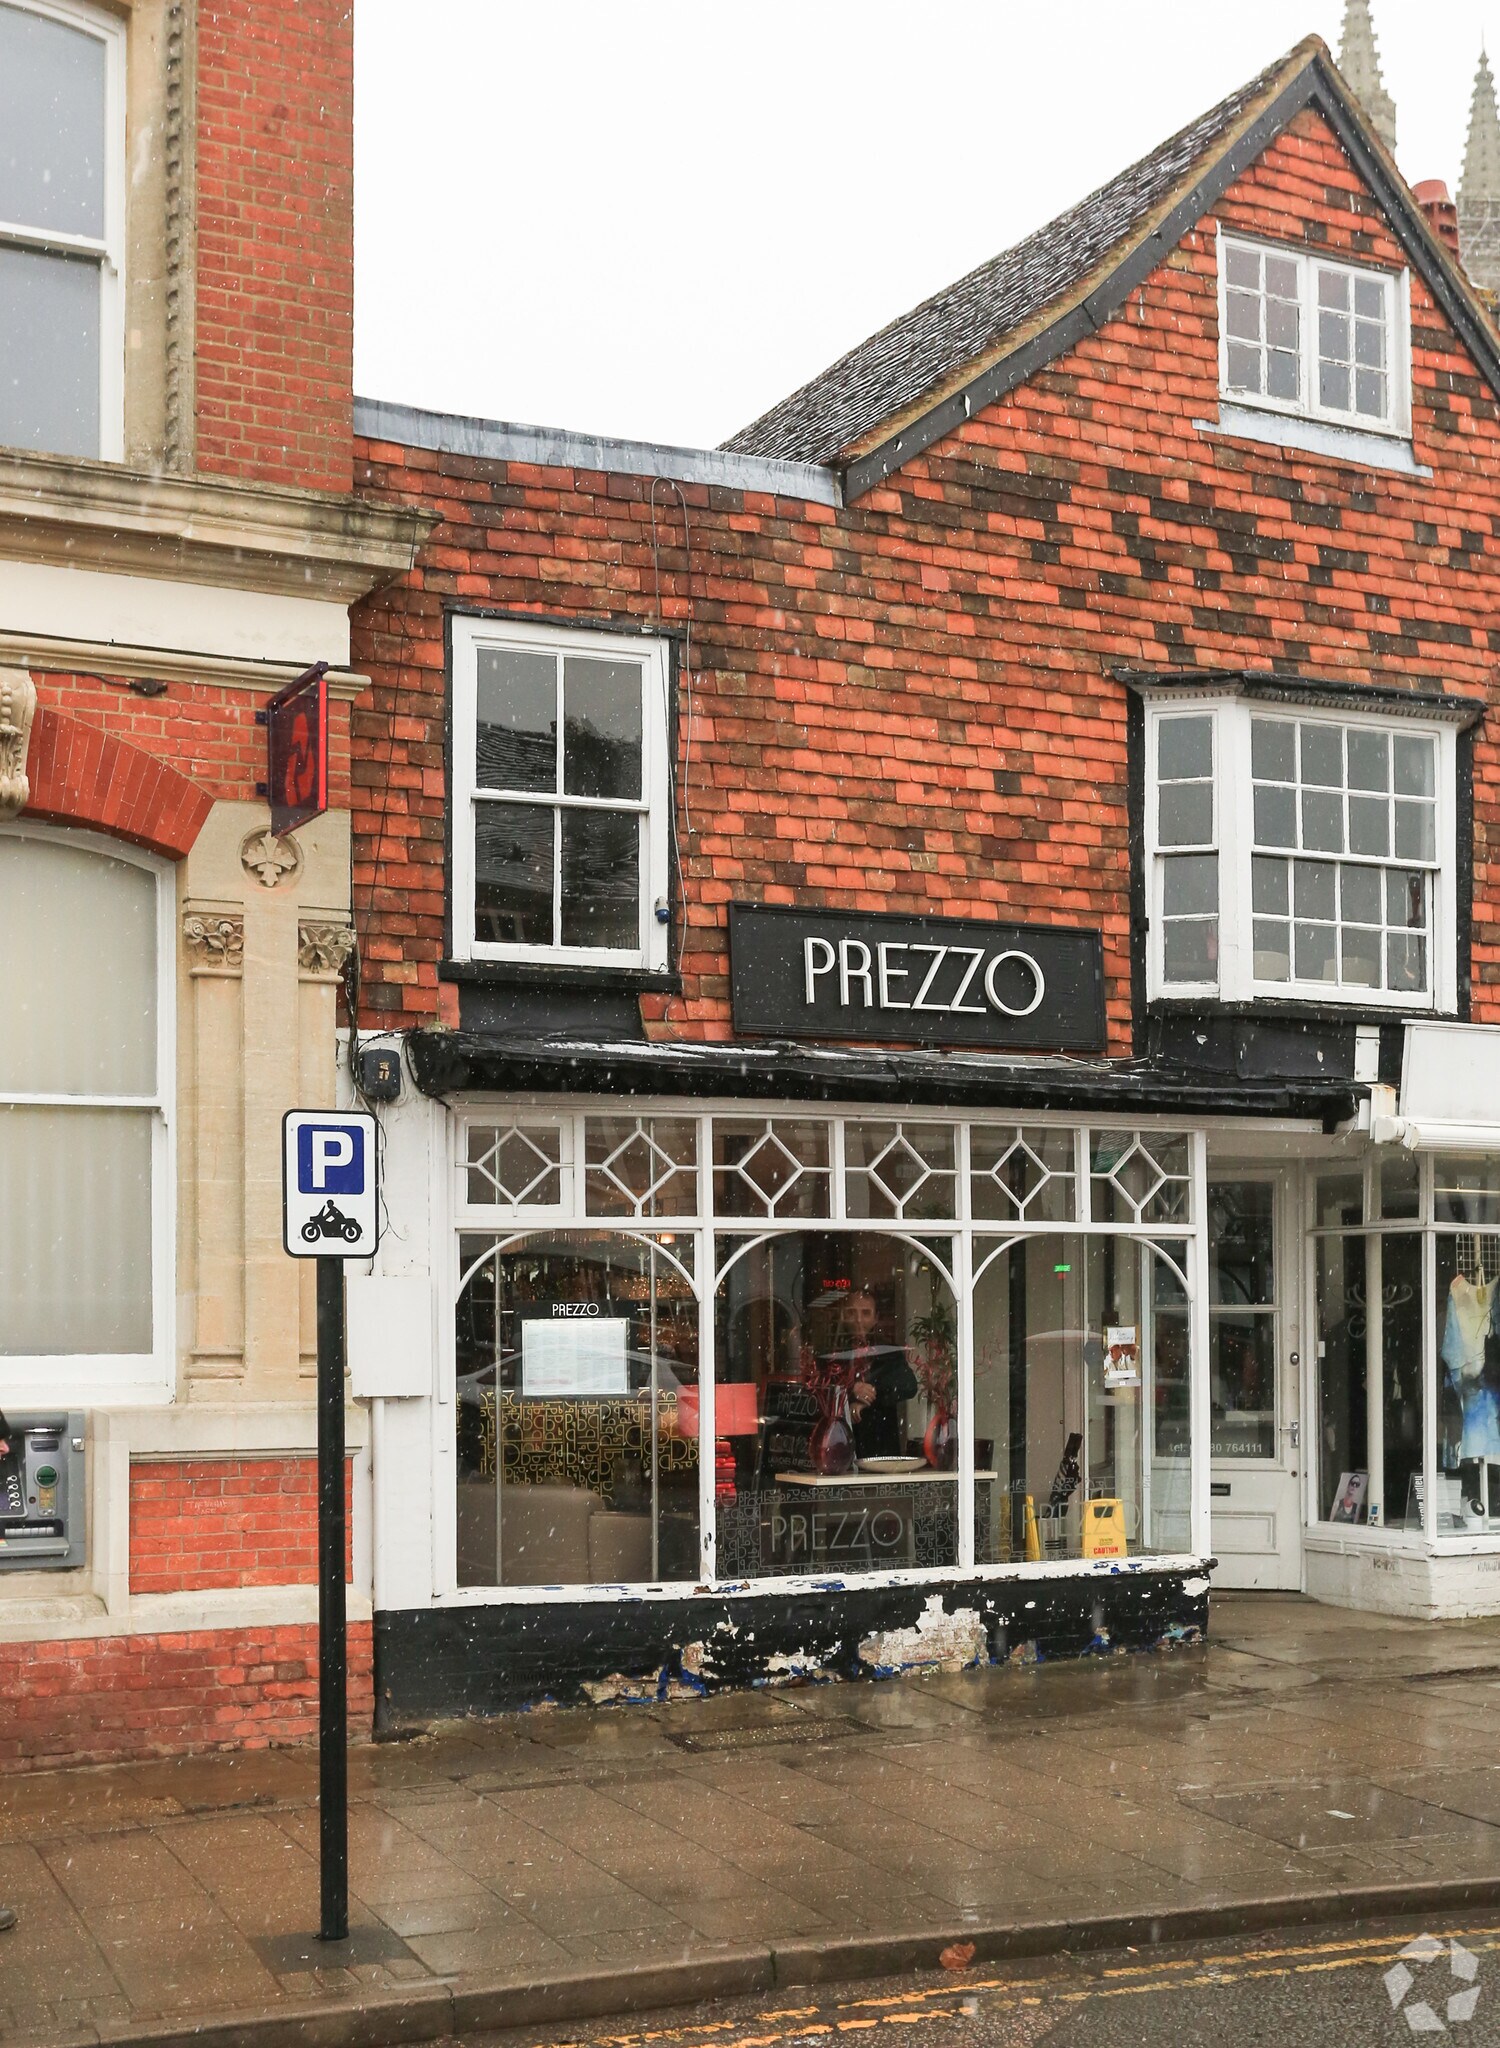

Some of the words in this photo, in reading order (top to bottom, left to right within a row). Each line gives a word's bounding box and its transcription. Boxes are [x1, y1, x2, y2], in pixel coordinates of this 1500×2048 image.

[803, 937, 1046, 1017] PREZZO
[312, 1131, 354, 1188] P
[552, 1303, 600, 1317] PREZZO
[777, 1392, 818, 1416] PREZZO
[1168, 1443, 1186, 1452] tel.
[1225, 1443, 1262, 1453] 764111
[1414, 1475, 1424, 1500] Ridley
[771, 1509, 903, 1552] PREZZO
[1022, 1499, 1141, 1539] PREZZO
[1093, 1546, 1119, 1555] CAUTION
